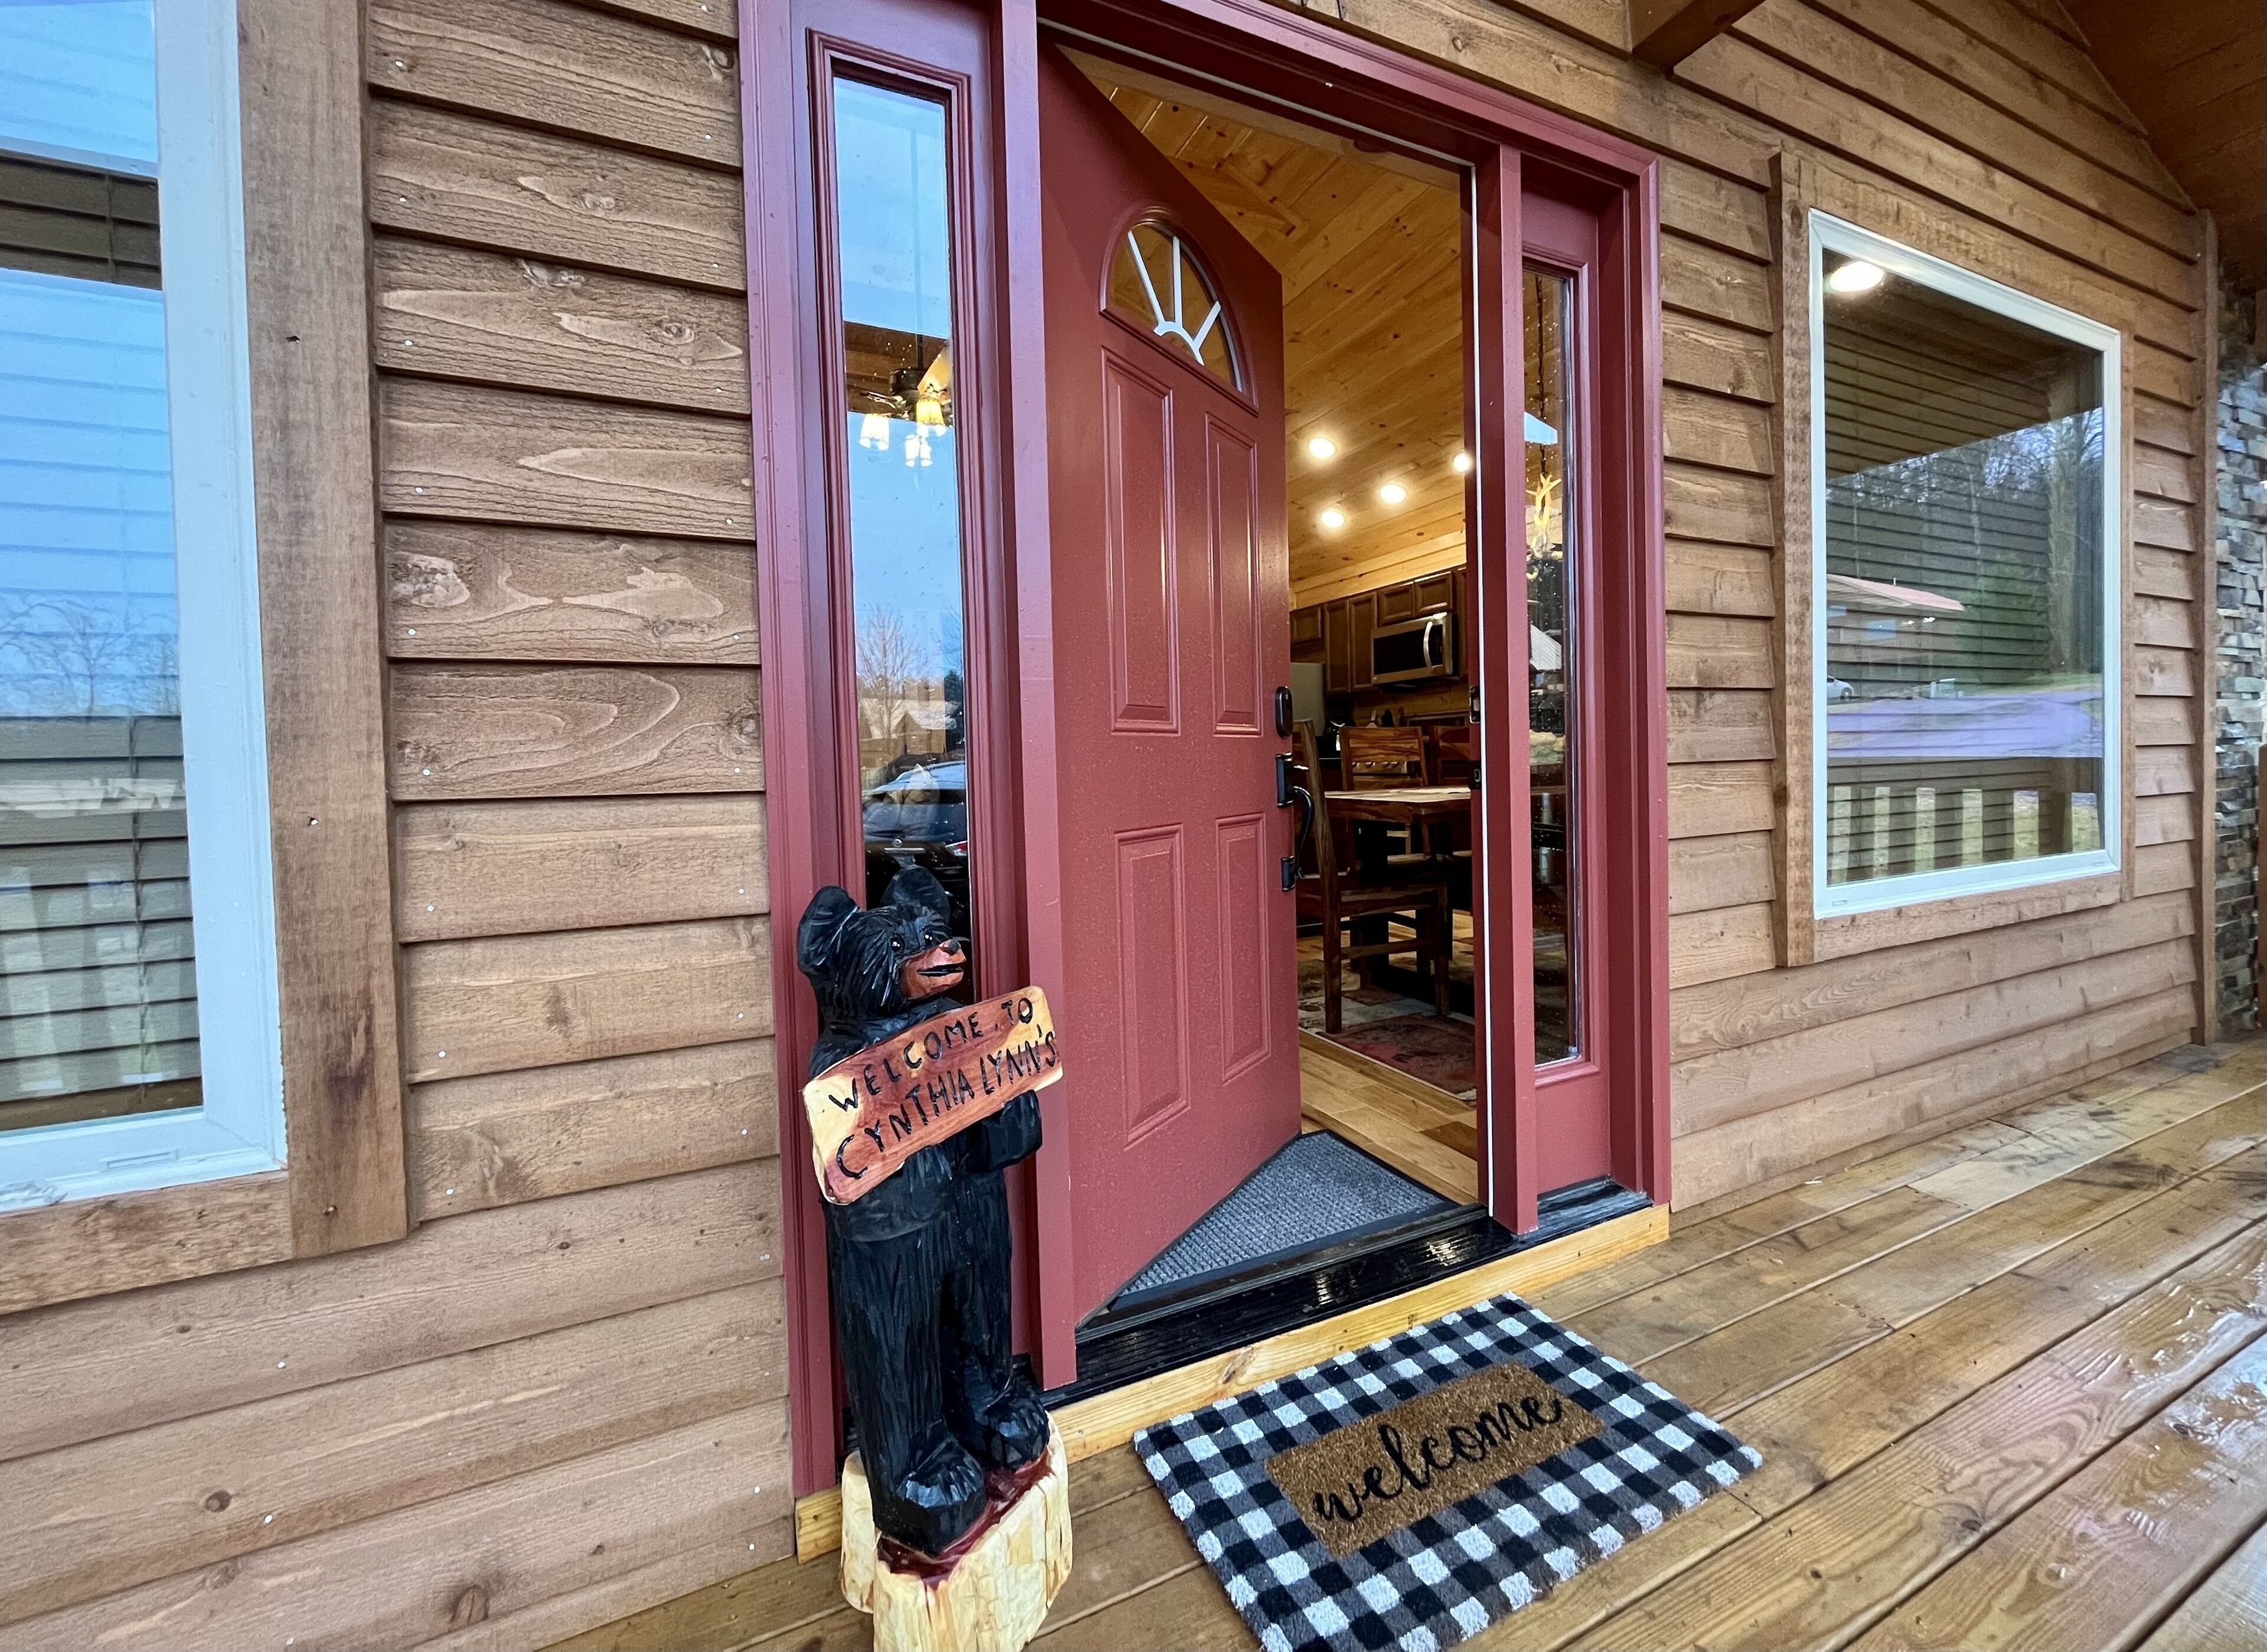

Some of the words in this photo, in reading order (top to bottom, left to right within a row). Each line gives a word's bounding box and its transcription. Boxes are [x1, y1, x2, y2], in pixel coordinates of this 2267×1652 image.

[828, 1011, 984, 1112] WELCOME
[1001, 997, 1034, 1026] TO
[836, 1067, 975, 1180] CYNTHIA
[979, 1024, 1056, 1095] LYNN'S
[1312, 1396, 1564, 1523] welcome
